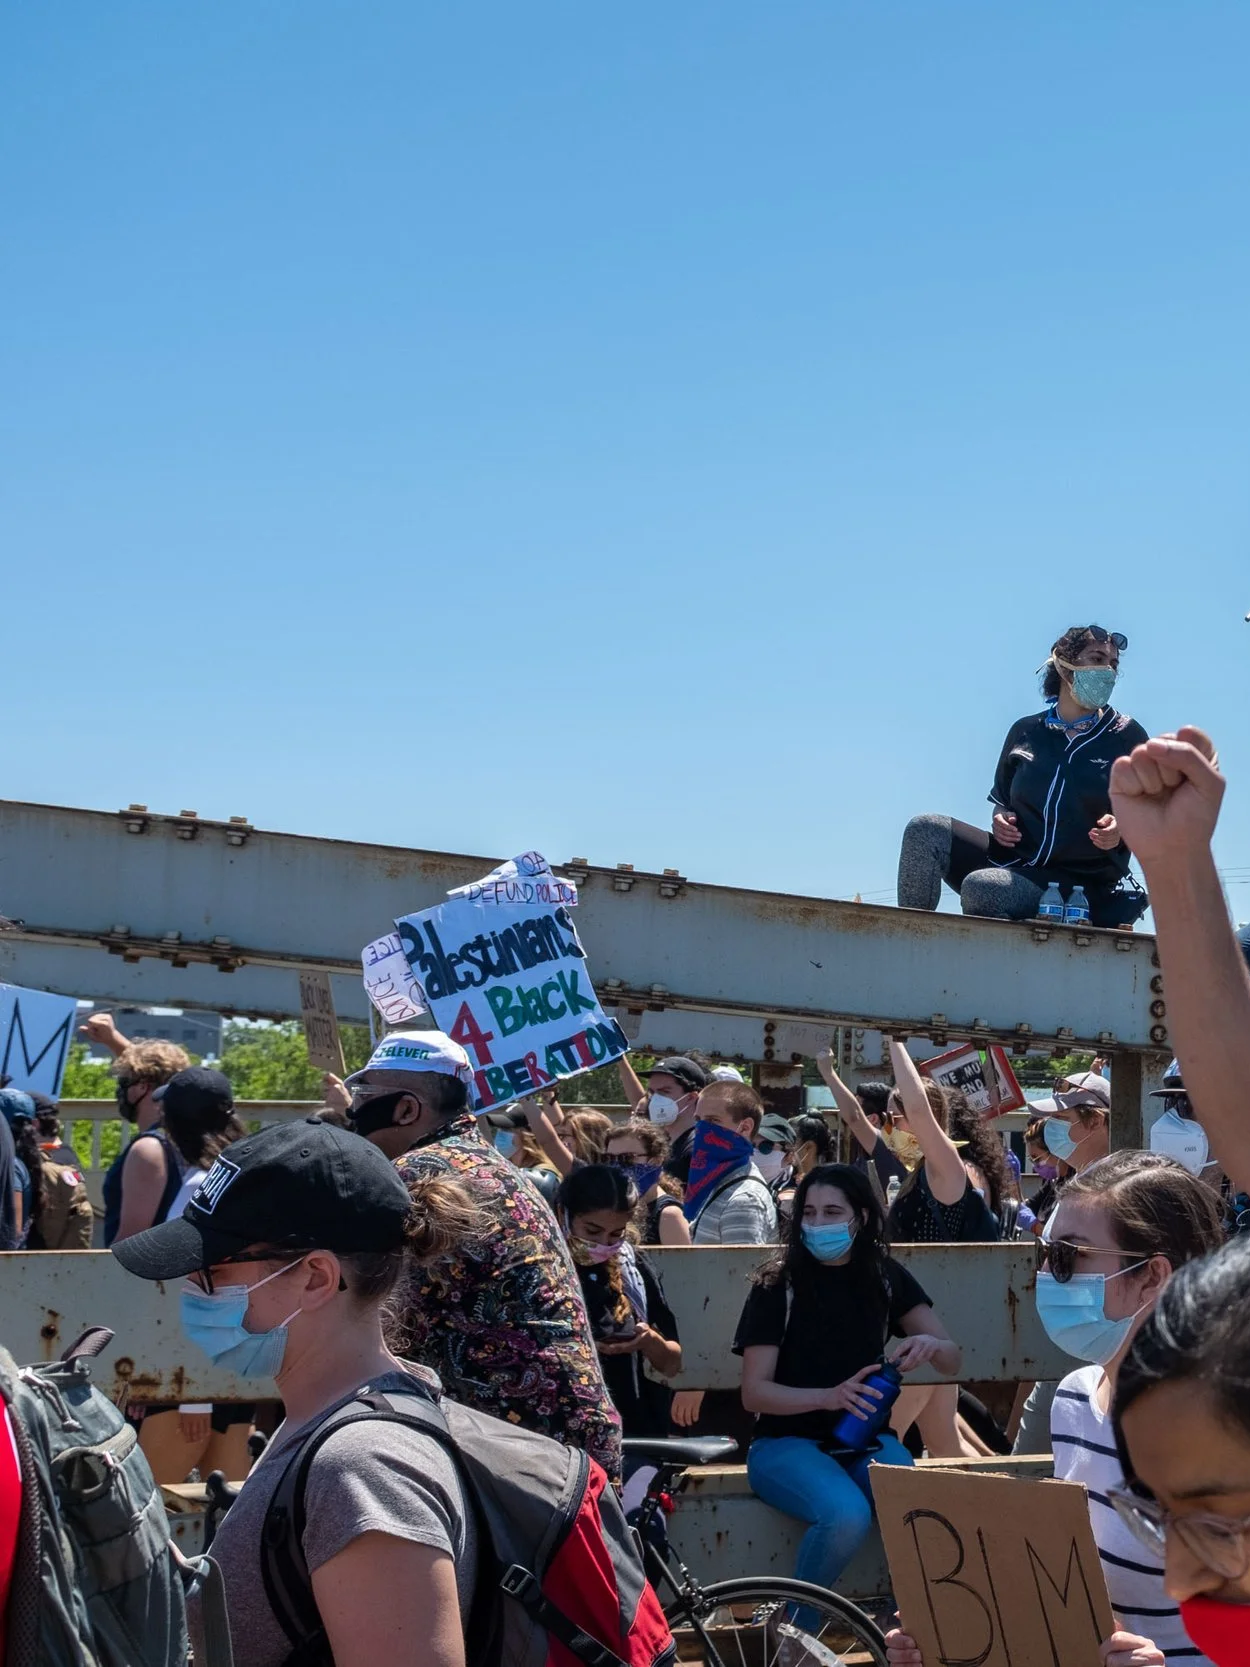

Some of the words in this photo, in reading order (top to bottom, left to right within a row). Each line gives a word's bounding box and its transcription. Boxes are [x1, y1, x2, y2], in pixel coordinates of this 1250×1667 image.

[469, 882, 535, 904] DEFUND
[536, 883, 577, 904] POLICE
[451, 1000, 493, 1065] 4
[485, 969, 596, 1037] Black
[476, 1019, 628, 1109] IBERATION
[940, 1070, 957, 1087] WE
[961, 1079, 985, 1095] END
